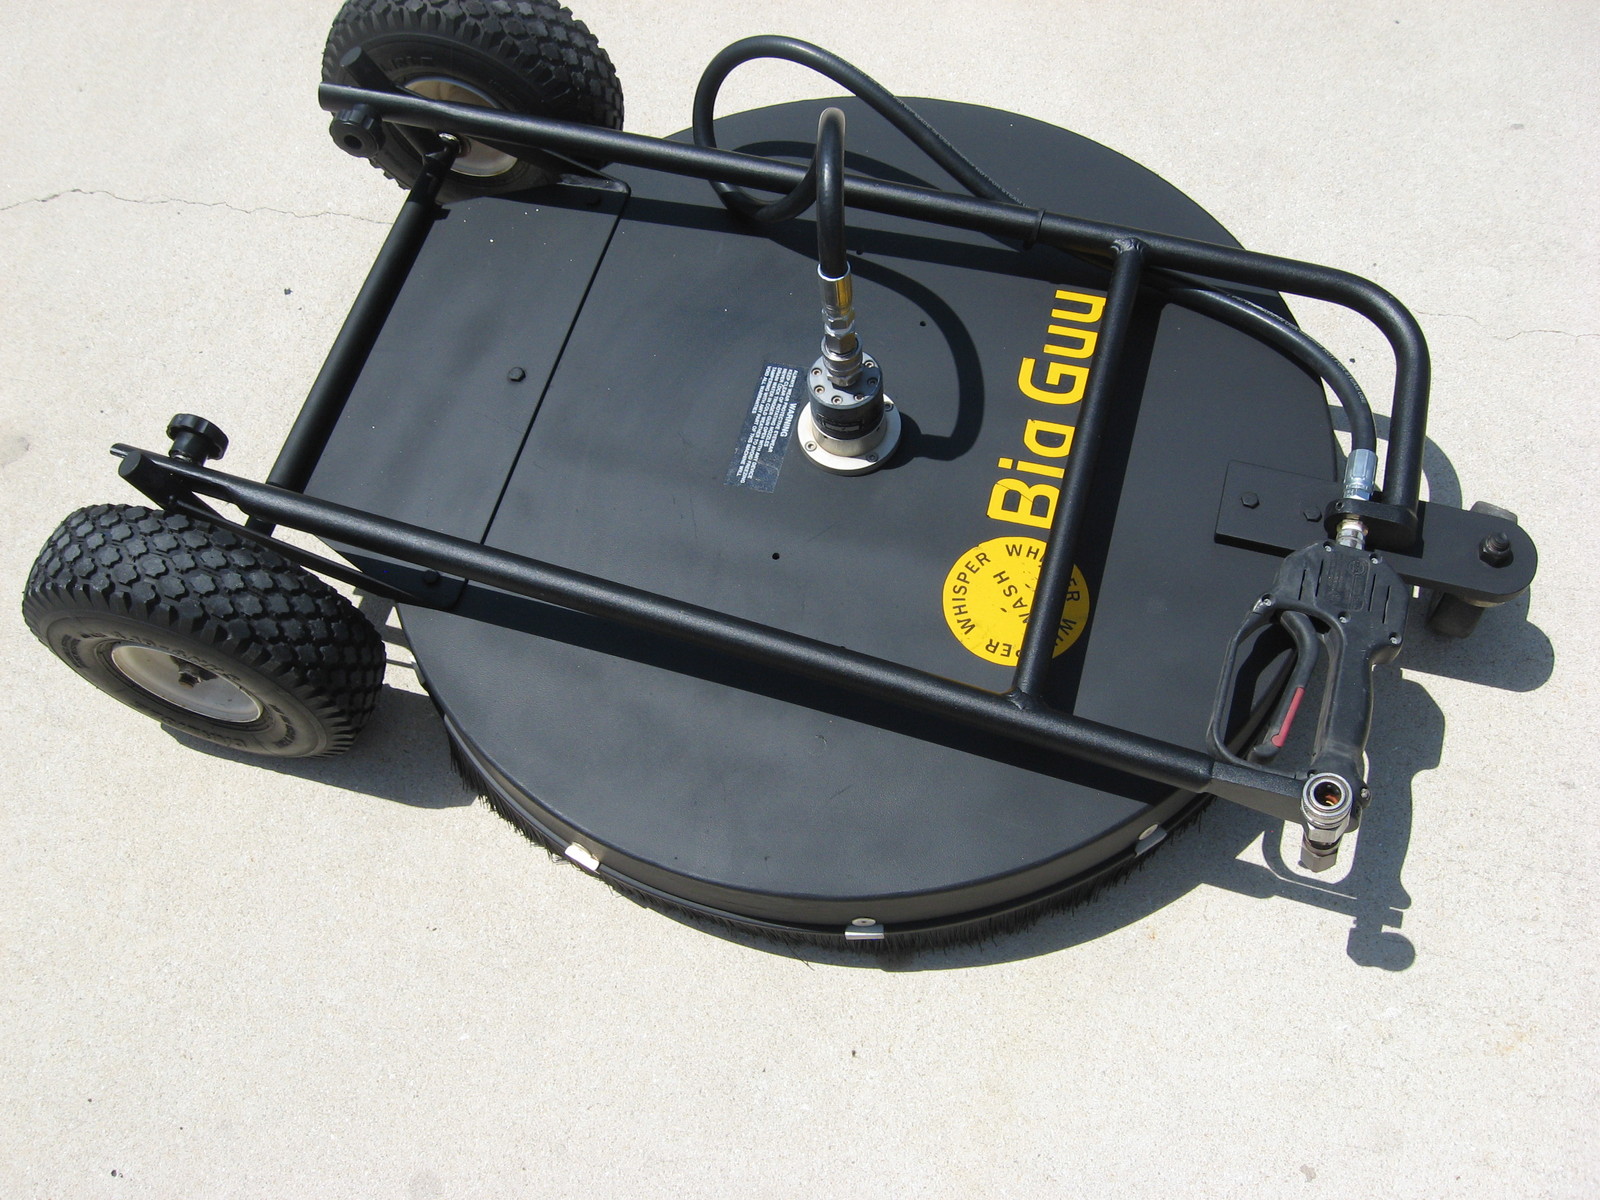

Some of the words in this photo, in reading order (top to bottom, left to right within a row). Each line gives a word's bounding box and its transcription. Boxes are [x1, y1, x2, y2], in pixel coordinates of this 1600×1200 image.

[1018, 290, 1106, 405] Guy
[780, 402, 797, 437] WARNING
[987, 419, 1075, 529] Big
[952, 552, 991, 635] WHISPER
